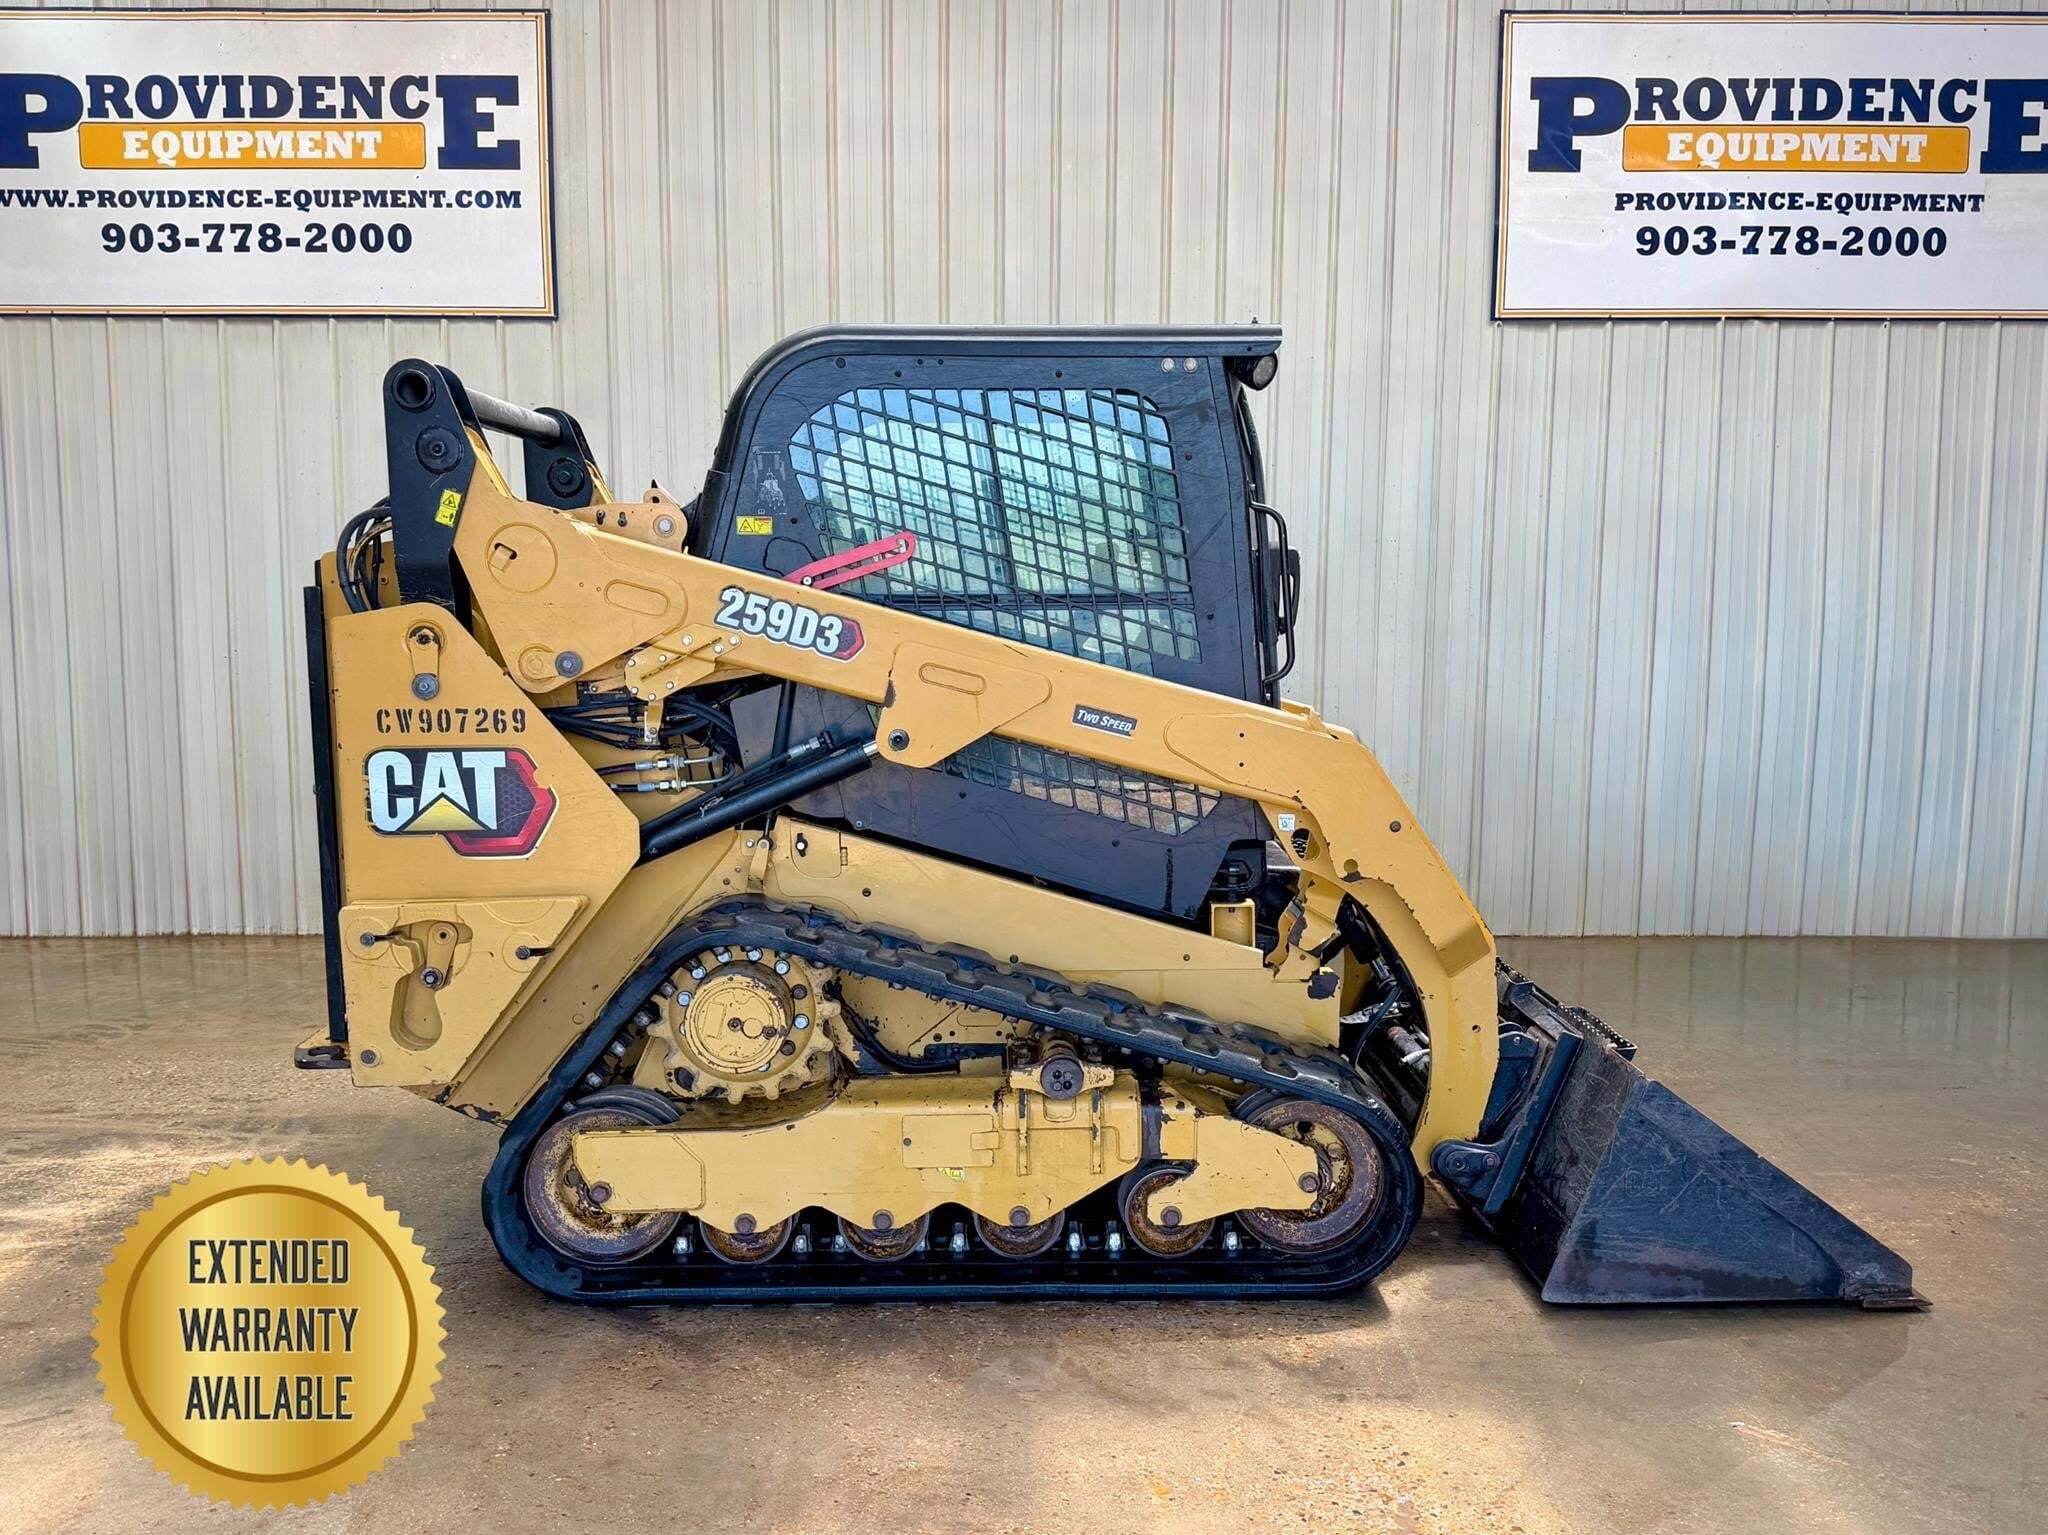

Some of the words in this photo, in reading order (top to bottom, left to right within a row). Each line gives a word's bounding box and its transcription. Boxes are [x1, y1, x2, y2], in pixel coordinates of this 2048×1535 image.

[0, 73, 520, 170] PROVIDENCE
[1528, 76, 2048, 173] PROVIDENCE
[123, 130, 382, 167] EQUIPMENT
[1666, 132, 1928, 169] EQUIPMENT
[1614, 191, 1985, 216] PROVIDENCE-EQUIPMENT
[101, 222, 412, 253] 903-778-2000
[1636, 225, 1947, 256] 903-778-2000
[716, 587, 843, 654] 259D3
[376, 707, 526, 734] CW907269
[367, 750, 507, 832] CAT
